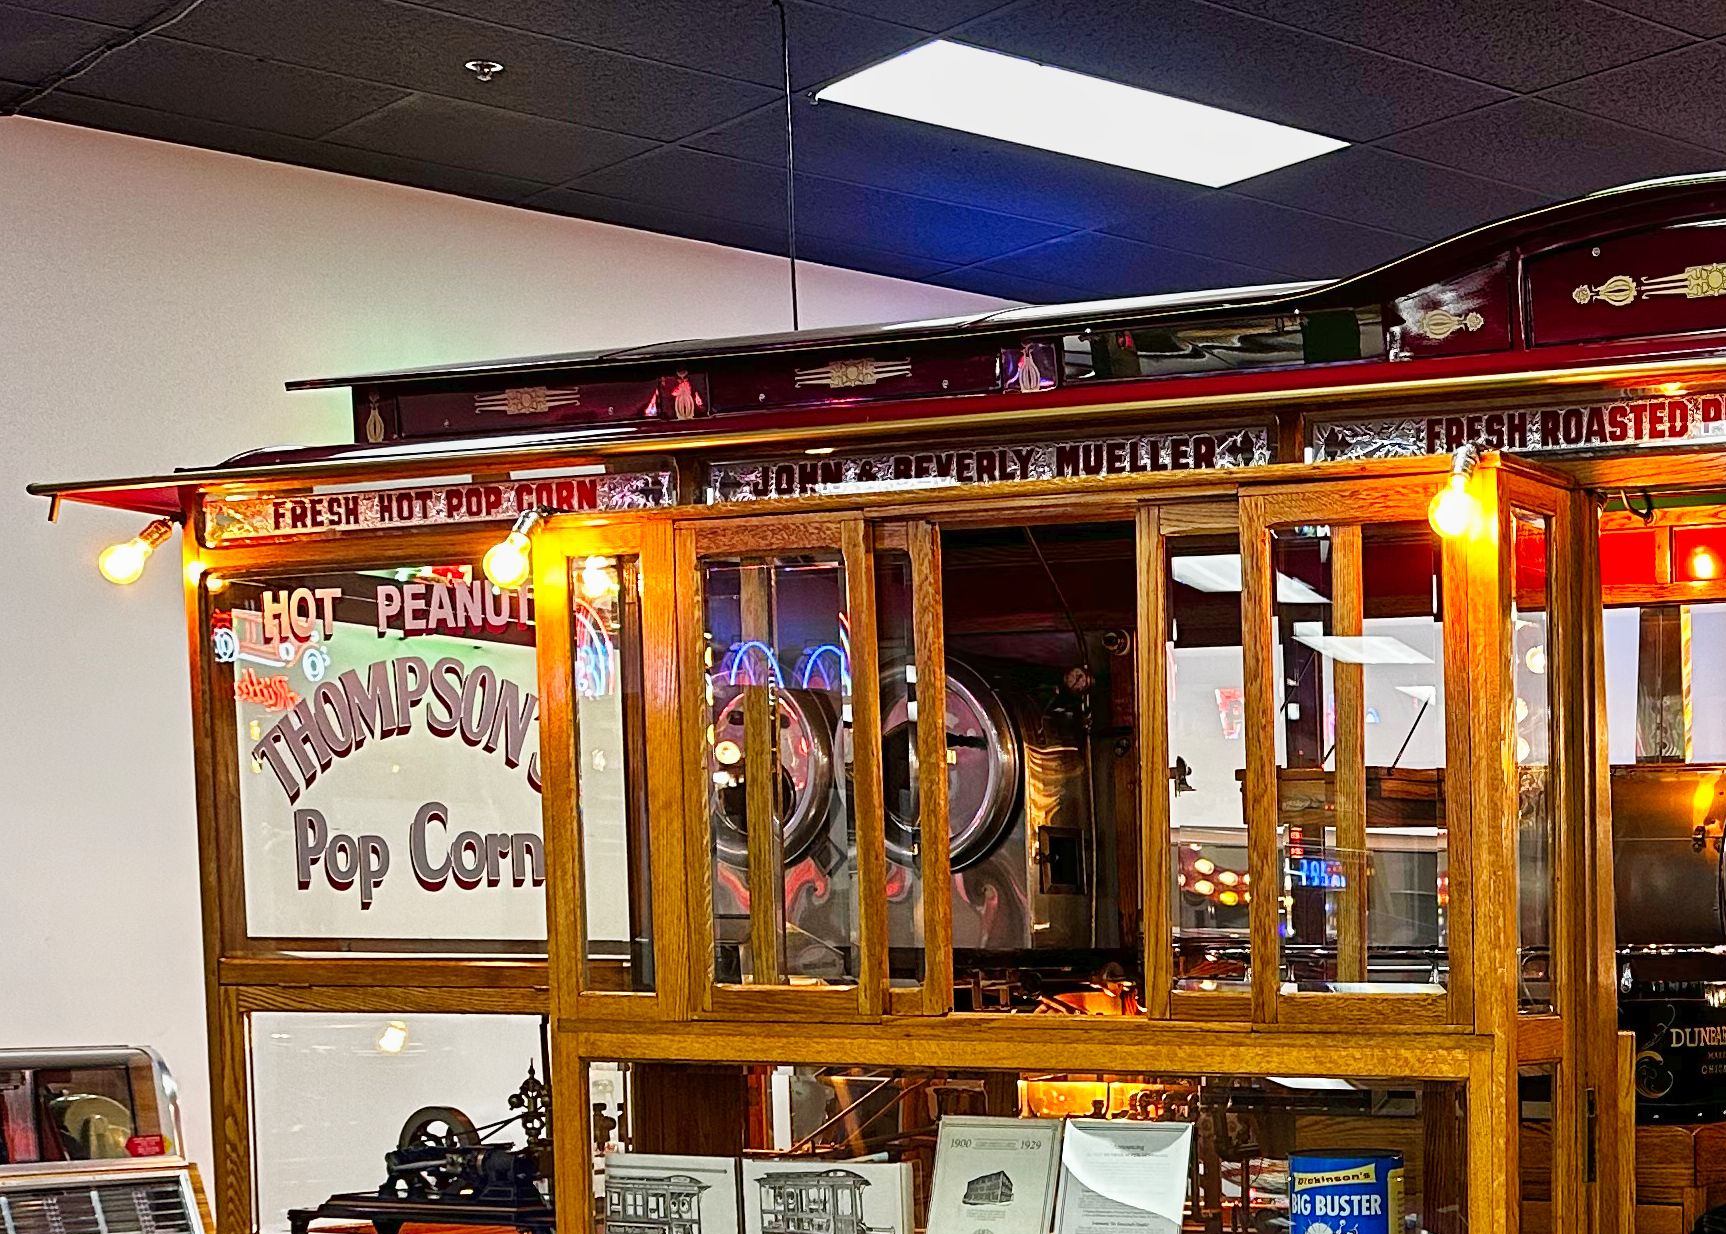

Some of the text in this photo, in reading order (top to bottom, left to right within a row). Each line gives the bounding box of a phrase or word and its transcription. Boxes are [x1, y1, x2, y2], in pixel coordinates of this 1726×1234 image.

[1426, 411, 1529, 453] FRESH
[1540, 399, 1690, 446] ROASTED
[752, 434, 1218, 497] JOHN & BEVERLY MUELLER
[272, 478, 598, 531] FRESH HOT POP CORN
[261, 587, 342, 643] HOT
[251, 656, 543, 807] THOMPSON
[293, 800, 546, 911] Pop Corn
[1020, 1139, 1042, 1150] 1929
[1291, 1193, 1382, 1217] BIG BUSTER
